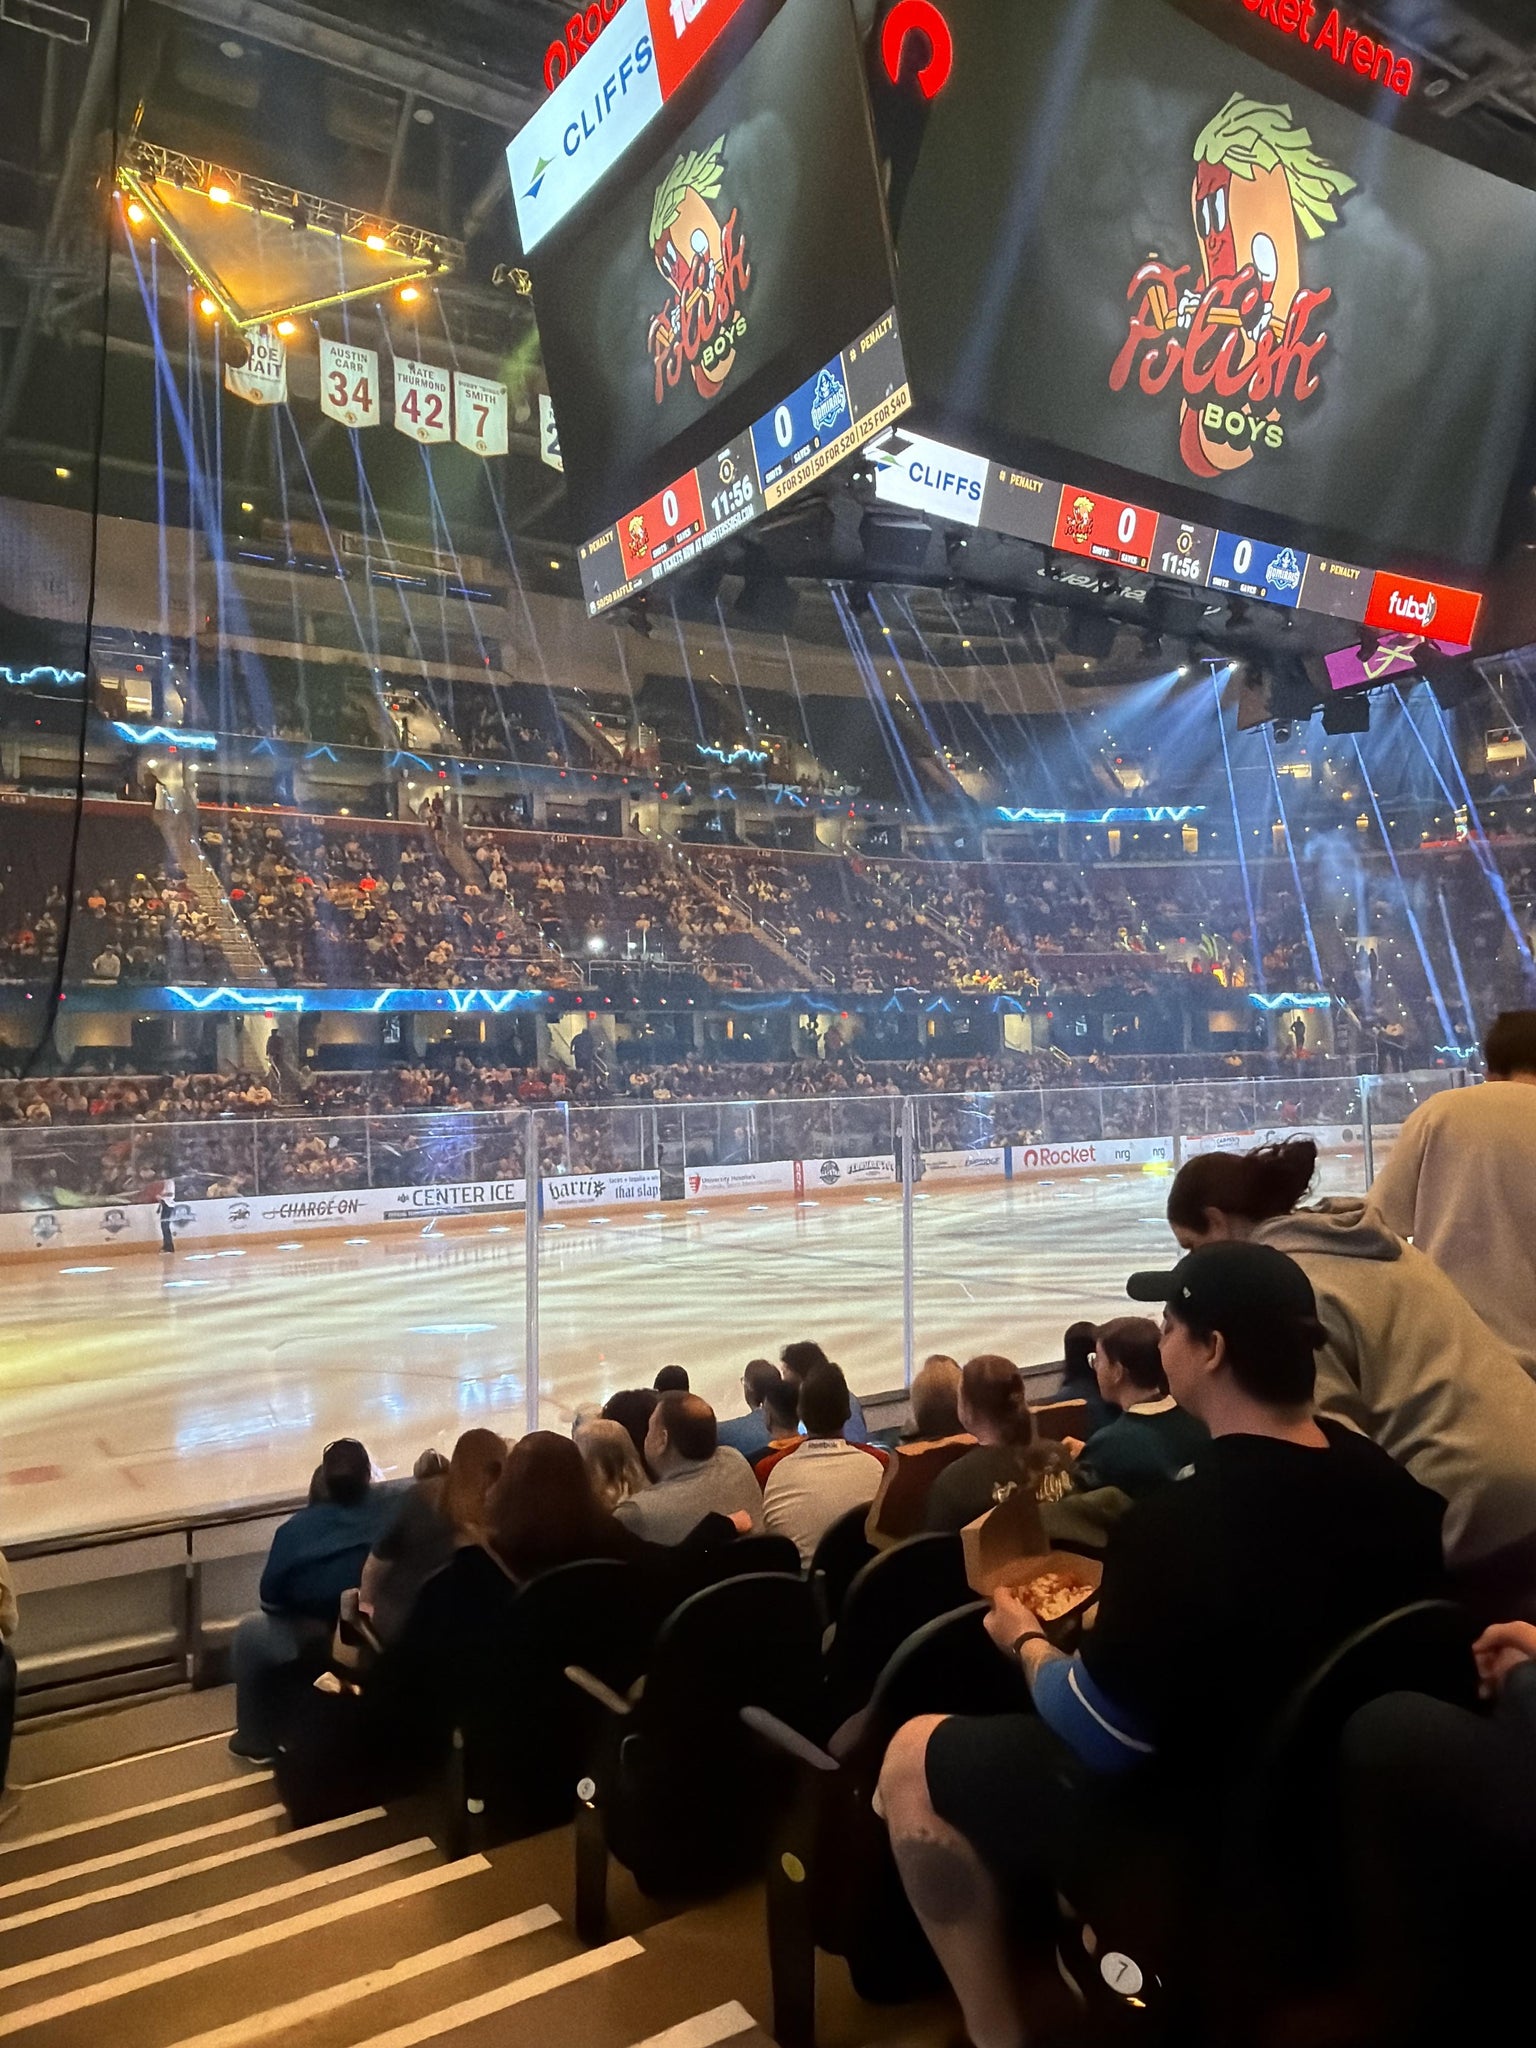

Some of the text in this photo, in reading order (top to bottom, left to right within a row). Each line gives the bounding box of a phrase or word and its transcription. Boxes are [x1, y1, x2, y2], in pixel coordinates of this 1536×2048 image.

[1314, 8, 1413, 96] Arena
[563, 35, 652, 156] CLIFFS
[703, 317, 747, 366] BOYS
[859, 315, 893, 354] PENALTY
[1109, 261, 1332, 401] Polish
[330, 347, 368, 363] AUSTIN
[335, 359, 364, 373] CARR
[397, 373, 446, 393] THURMOND
[409, 366, 434, 380] NATE
[328, 371, 372, 413] 34
[466, 389, 496, 404] SMITH
[401, 389, 443, 429] 42
[472, 404, 489, 438] 7
[1204, 402, 1283, 448] BOYS
[774, 405, 792, 448] 0
[776, 391, 907, 498] 5 FOR $10 50 FOR $20 125 FOR $40
[711, 474, 753, 521] 11:56
[909, 462, 982, 501] CLIFFS
[1010, 473, 1044, 493] PENALTY
[662, 489, 679, 527] 0
[1117, 507, 1137, 543] 0
[1161, 551, 1200, 580] 11:56
[1233, 539, 1252, 574] 0
[1330, 564, 1360, 581] PENALTY
[1388, 591, 1428, 622] fubo
[1040, 1145, 1096, 1165] Rocket
[1115, 1149, 1131, 1161] nrg
[1152, 1147, 1166, 1158] nrg
[413, 1184, 515, 1206] CENTER ICE
[615, 1184, 635, 1198] that
[279, 1199, 358, 1218] CHARGE ON
[1116, 1960, 1129, 1982] 7
